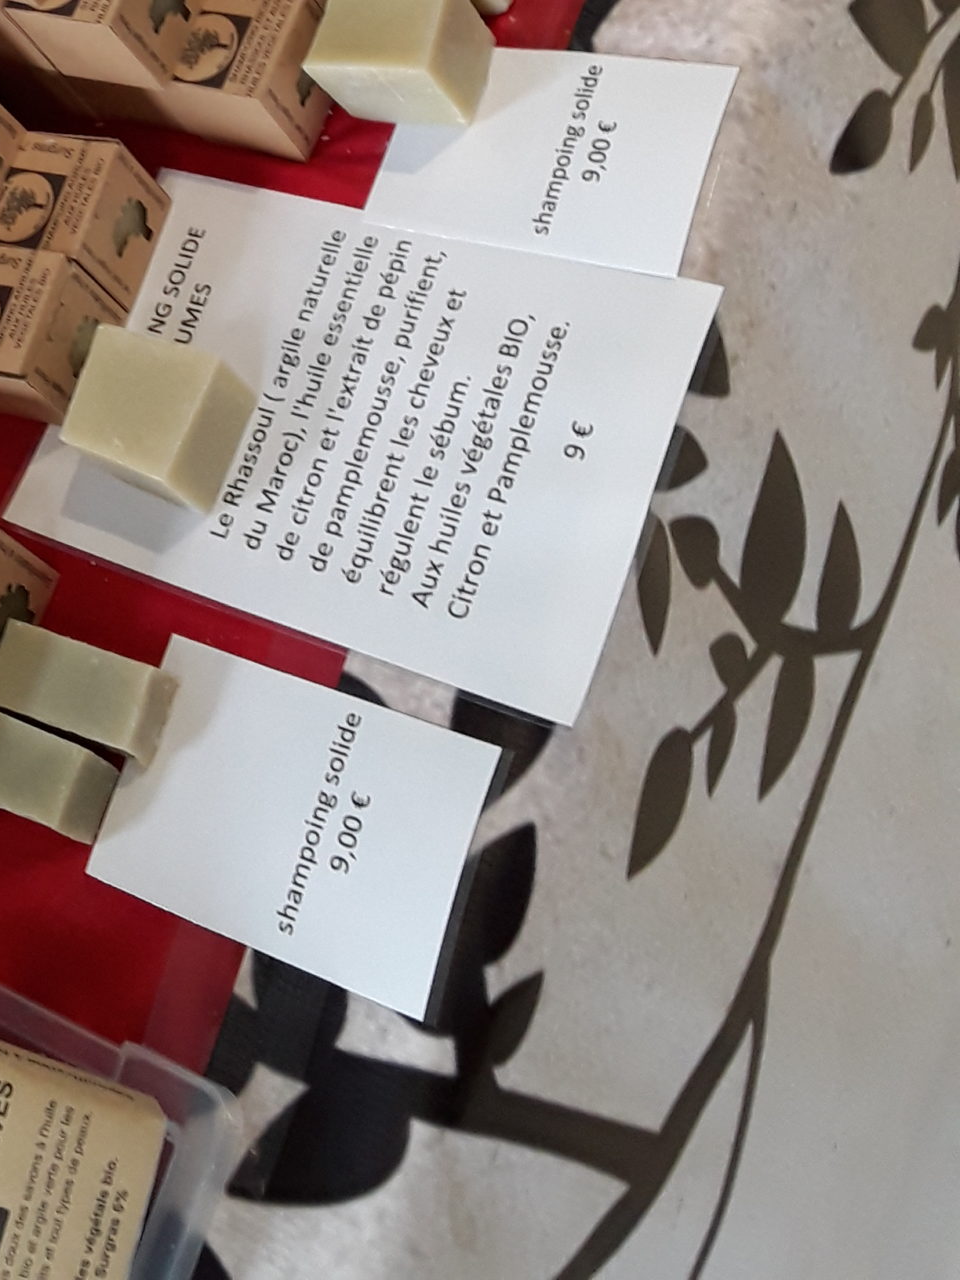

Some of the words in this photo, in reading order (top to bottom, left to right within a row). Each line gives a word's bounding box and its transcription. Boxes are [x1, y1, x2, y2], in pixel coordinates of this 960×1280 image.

[531, 125, 586, 235] shampoing
[571, 65, 604, 121] solide
[581, 138, 611, 182] 9,00
[597, 121, 617, 133] €
[162, 228, 205, 298] SOLIDE
[323, 236, 379, 347] essentielle
[378, 240, 412, 300] pépin
[174, 283, 212, 344] UMES
[362, 304, 386, 331] de
[498, 315, 536, 358] BIO,
[209, 513, 234, 539] Le
[222, 406, 275, 507] Rhassoul
[273, 328, 306, 389] argile
[297, 230, 347, 322] naturelle
[290, 352, 332, 420] l'huile
[308, 542, 334, 572] de
[325, 356, 406, 538] pamplemousse,
[394, 251, 448, 350] purifient,
[325, 337, 374, 422] l'extrait
[486, 322, 570, 504] Pamplemousse.
[320, 428, 340, 451] et
[460, 365, 513, 474] végétales
[563, 444, 586, 460] 9
[571, 421, 594, 437] €
[255, 428, 307, 514] Maroc),
[291, 458, 328, 525] citron
[243, 520, 268, 550] du
[276, 531, 300, 561] de
[427, 482, 471, 555] huiles
[481, 509, 503, 537] et
[411, 560, 444, 609] Aux
[447, 544, 492, 619] Citron
[276, 790, 338, 935] shampoing
[324, 712, 362, 786] solide
[330, 815, 363, 874] 9,00
[351, 791, 371, 809] €
